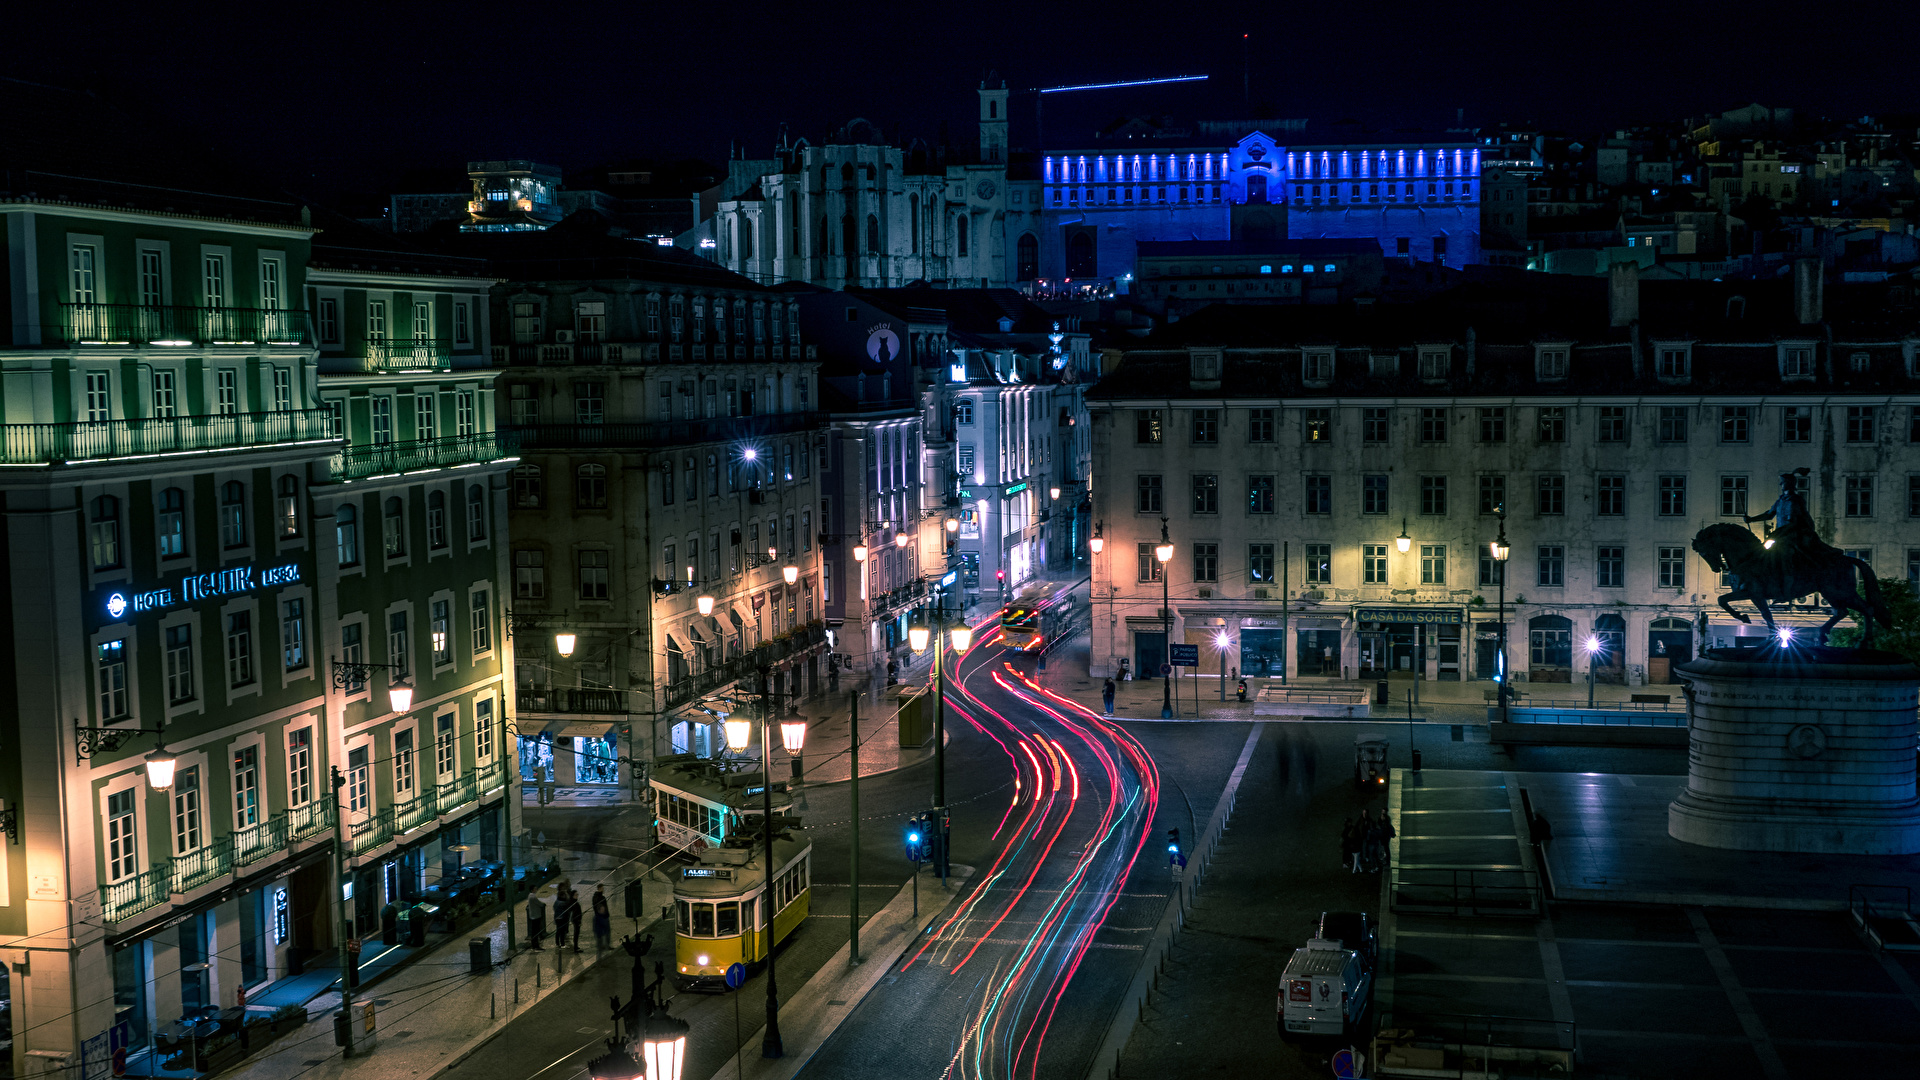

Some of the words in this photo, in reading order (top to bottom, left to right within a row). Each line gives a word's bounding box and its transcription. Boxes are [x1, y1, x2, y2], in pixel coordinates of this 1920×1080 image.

[867, 322, 891, 335] Hotel
[134, 588, 176, 611] HOTEL
[262, 564, 300, 587] LISBOA
[1361, 611, 1394, 622] CASA
[1397, 612, 1413, 622] DA
[1417, 613, 1459, 623] SORTE
